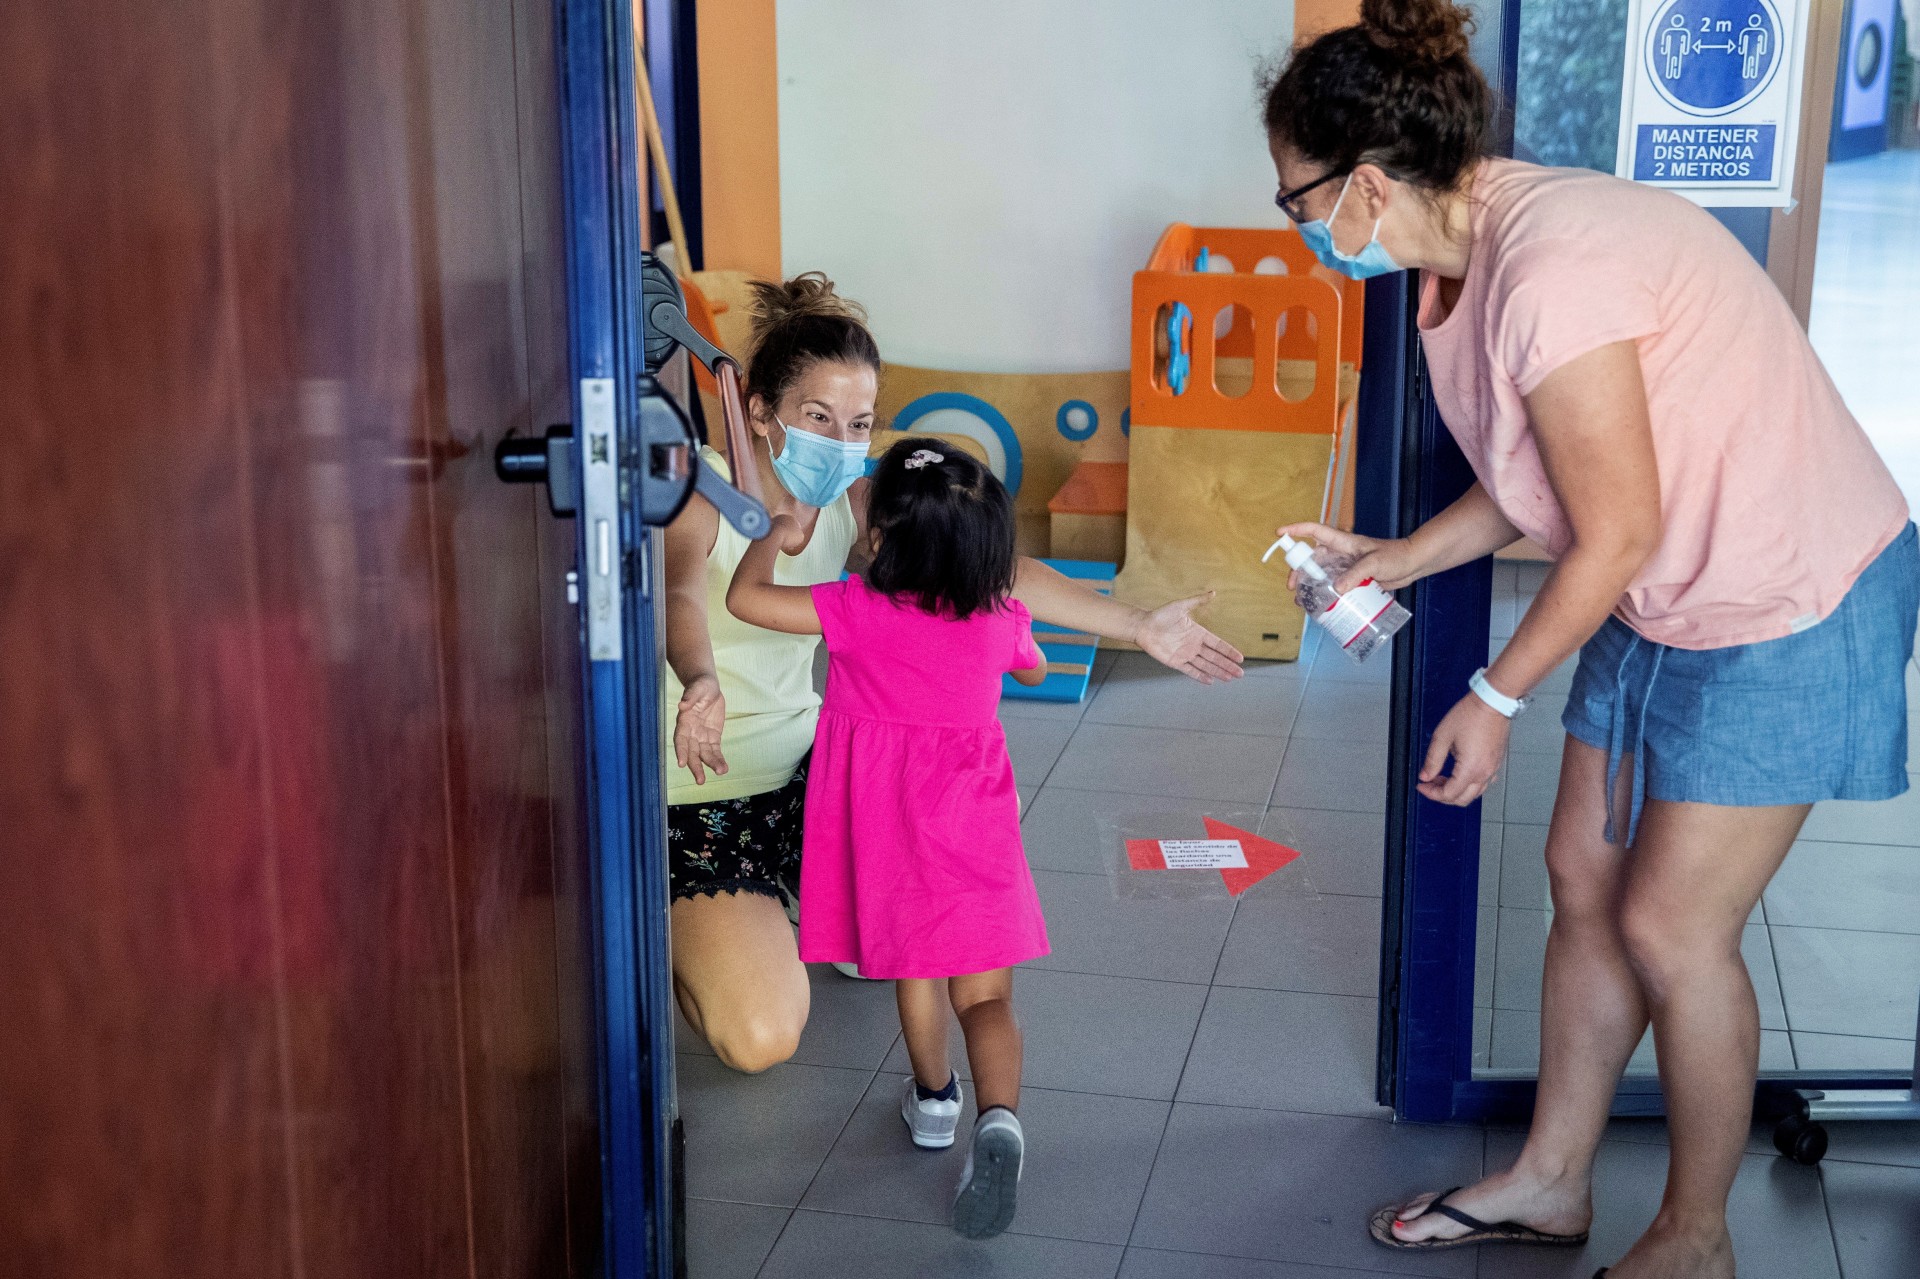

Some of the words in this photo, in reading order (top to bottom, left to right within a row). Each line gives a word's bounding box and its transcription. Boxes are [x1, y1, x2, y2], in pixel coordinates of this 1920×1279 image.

[1700, 17, 1711, 32] 2
[1715, 20, 1732, 32] m
[1652, 129, 1759, 143] MANTENER
[1653, 145, 1754, 160] DISTANCIA
[1654, 162, 1665, 176] 2
[1670, 162, 1750, 177] METROS
